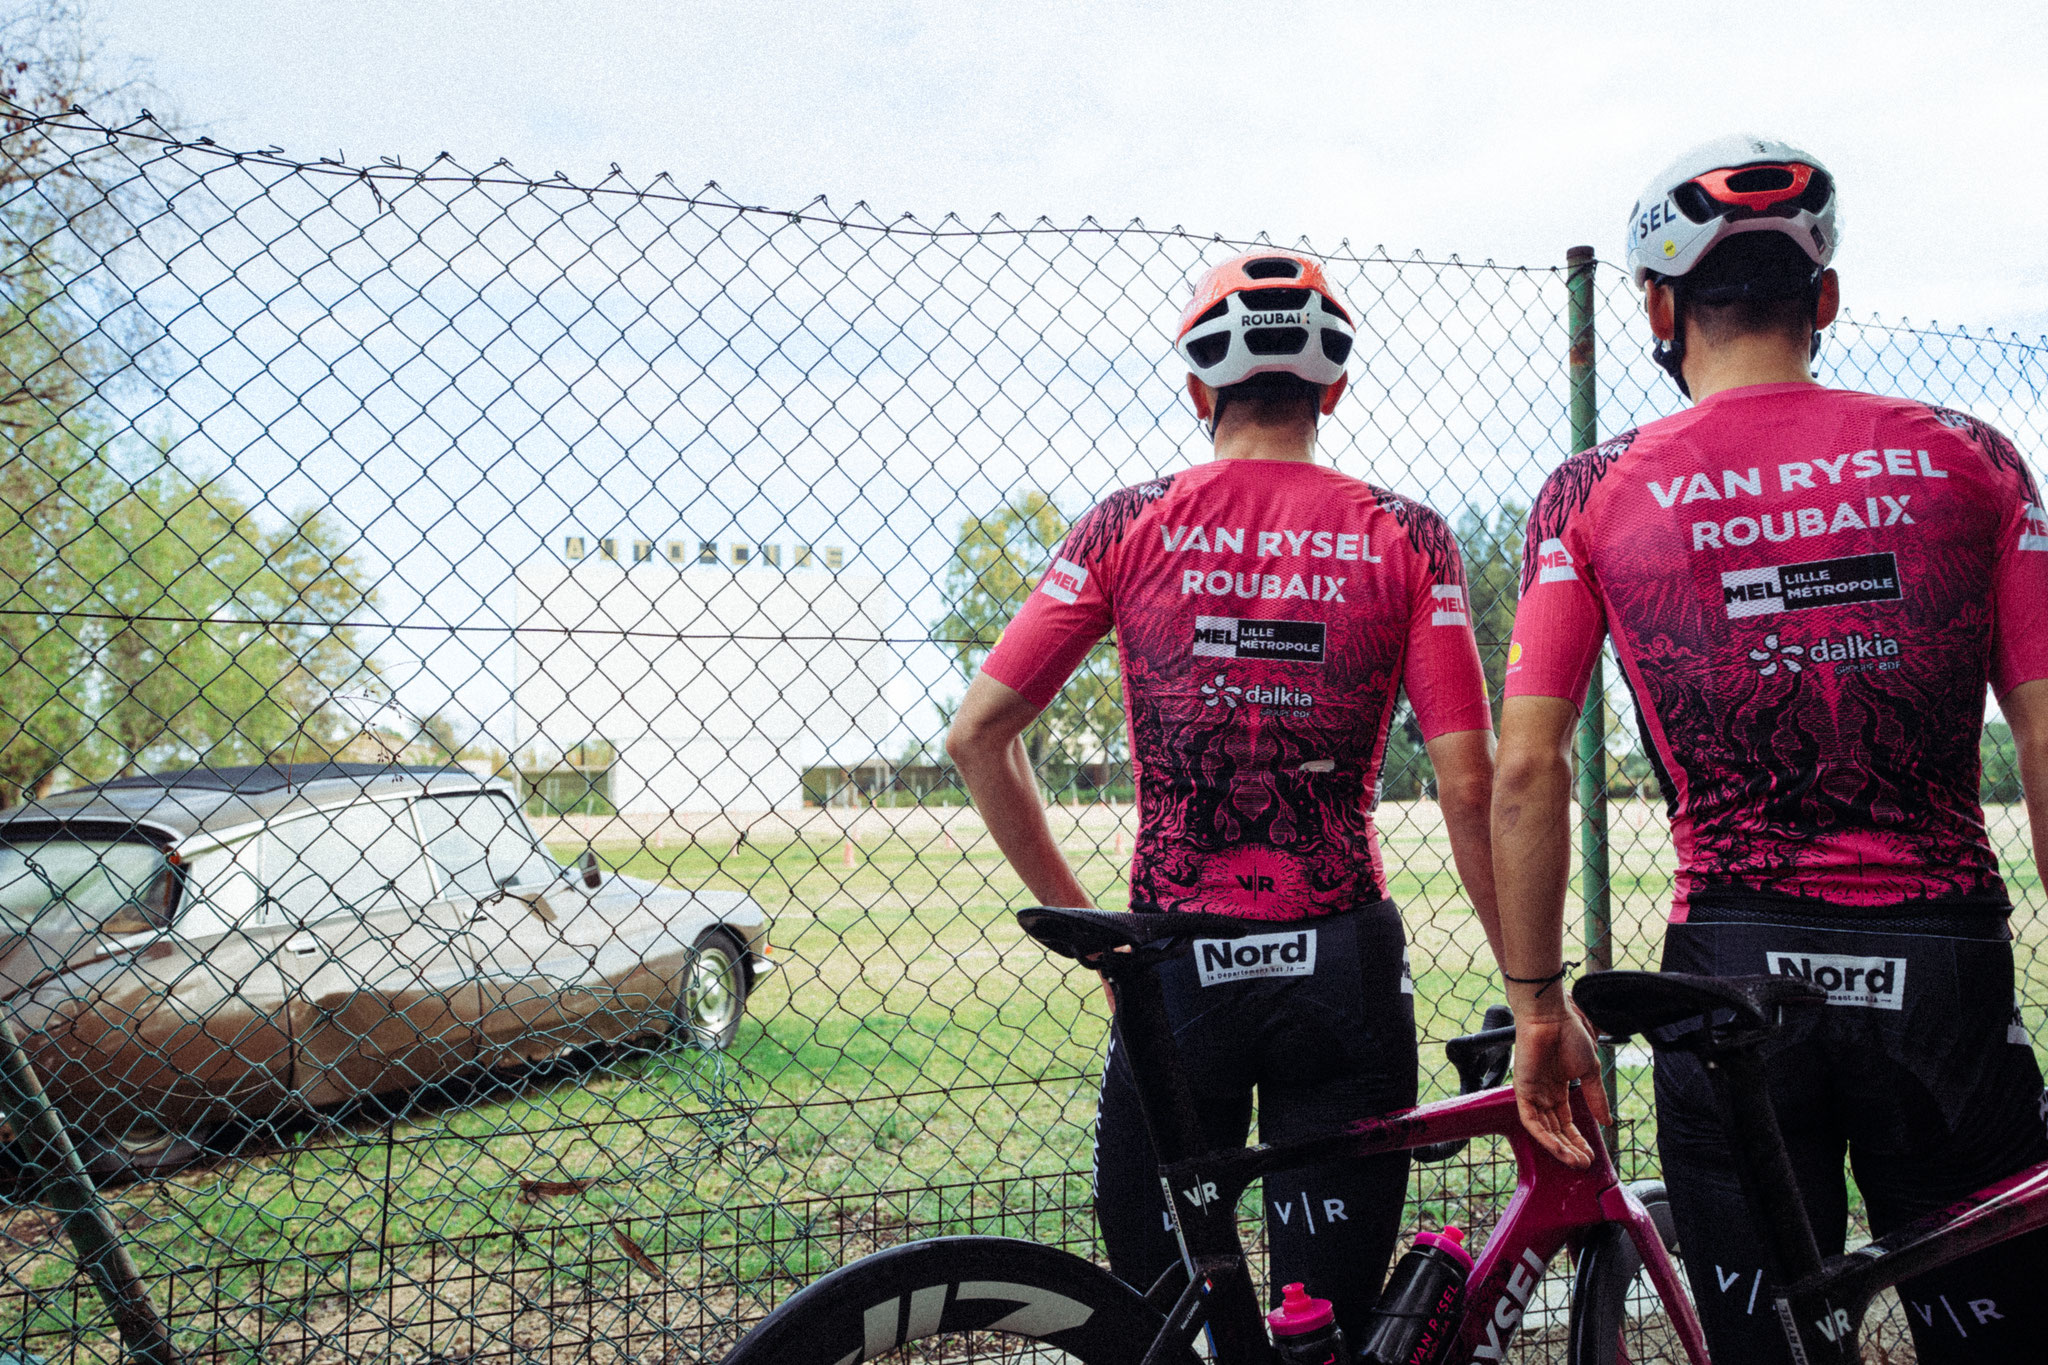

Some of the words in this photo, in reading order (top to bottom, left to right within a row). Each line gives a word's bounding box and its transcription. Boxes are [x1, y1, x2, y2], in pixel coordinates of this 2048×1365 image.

[1242, 312, 1310, 327] ROUBAIX
[1646, 466, 1762, 509] VAN
[1778, 449, 1949, 493] RYSEL
[1691, 494, 1916, 552] ROUBAIX
[1160, 524, 1245, 554] VAN
[1257, 528, 1382, 564] RYSEL
[1048, 567, 1081, 596] MEL
[1181, 569, 1348, 603] ROUBAIX
[1724, 578, 1781, 604] MEL
[1784, 569, 1831, 586] LILLE
[1787, 577, 1894, 600] MÉTROPOLE
[1432, 597, 1466, 613] MEL
[1194, 628, 1238, 646] MEL
[1240, 637, 1320, 653] MÉTROPOLE
[1241, 627, 1275, 638] LILLE
[1810, 633, 1899, 662] dalkia
[1245, 685, 1313, 707] dalkia
[1202, 933, 1307, 972] Nord
[1777, 957, 1895, 994] Nord
[1410, 1332, 1433, 1365] VAN
[1428, 1285, 1458, 1331] RSEL
